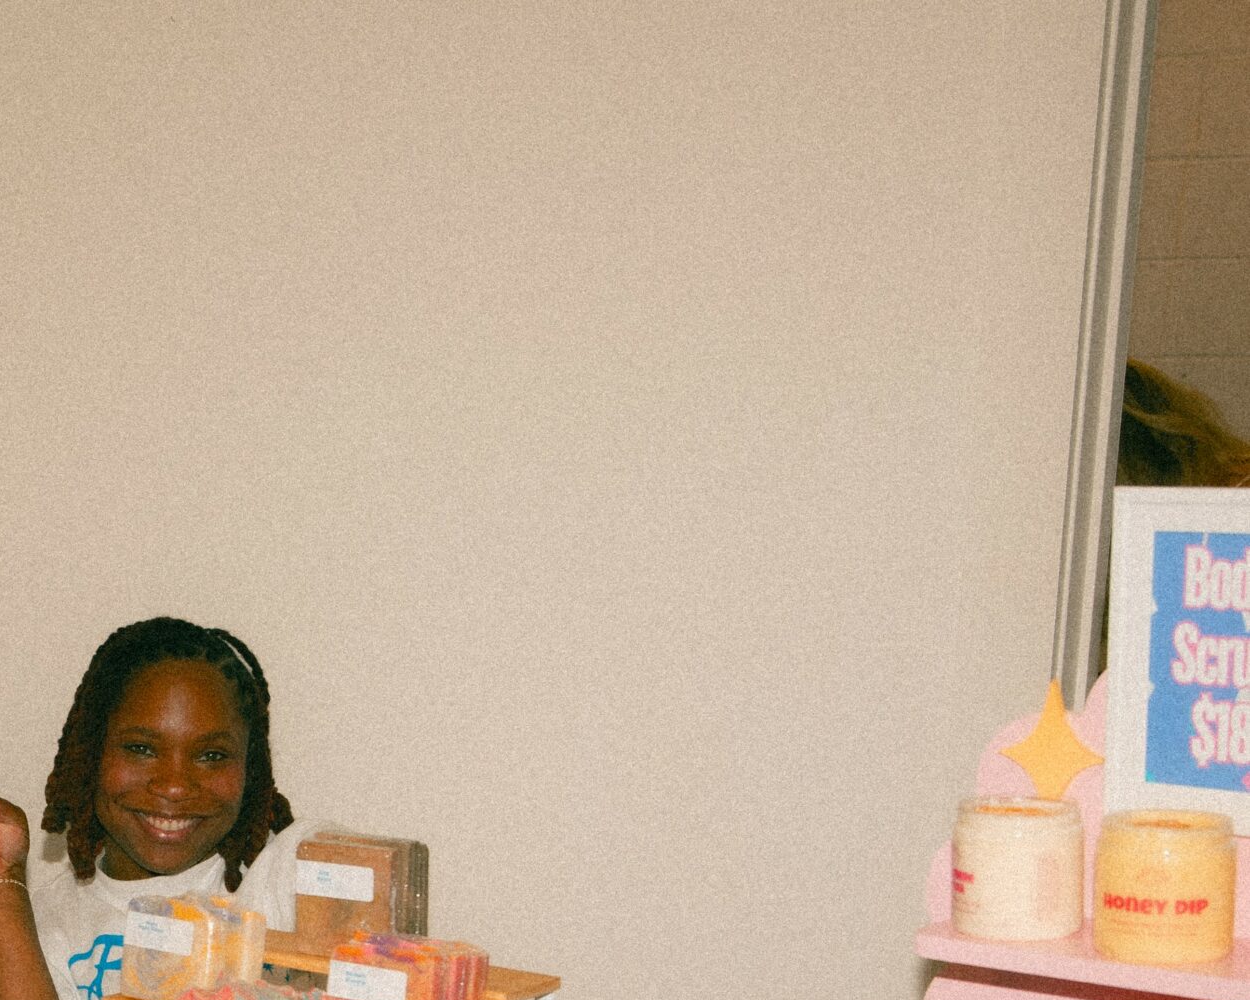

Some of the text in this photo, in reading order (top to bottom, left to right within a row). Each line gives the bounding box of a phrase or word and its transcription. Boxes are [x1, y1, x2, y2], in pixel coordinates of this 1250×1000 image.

[1188, 691, 1250, 768] $18
[1103, 892, 1208, 916] HONEY DIP
